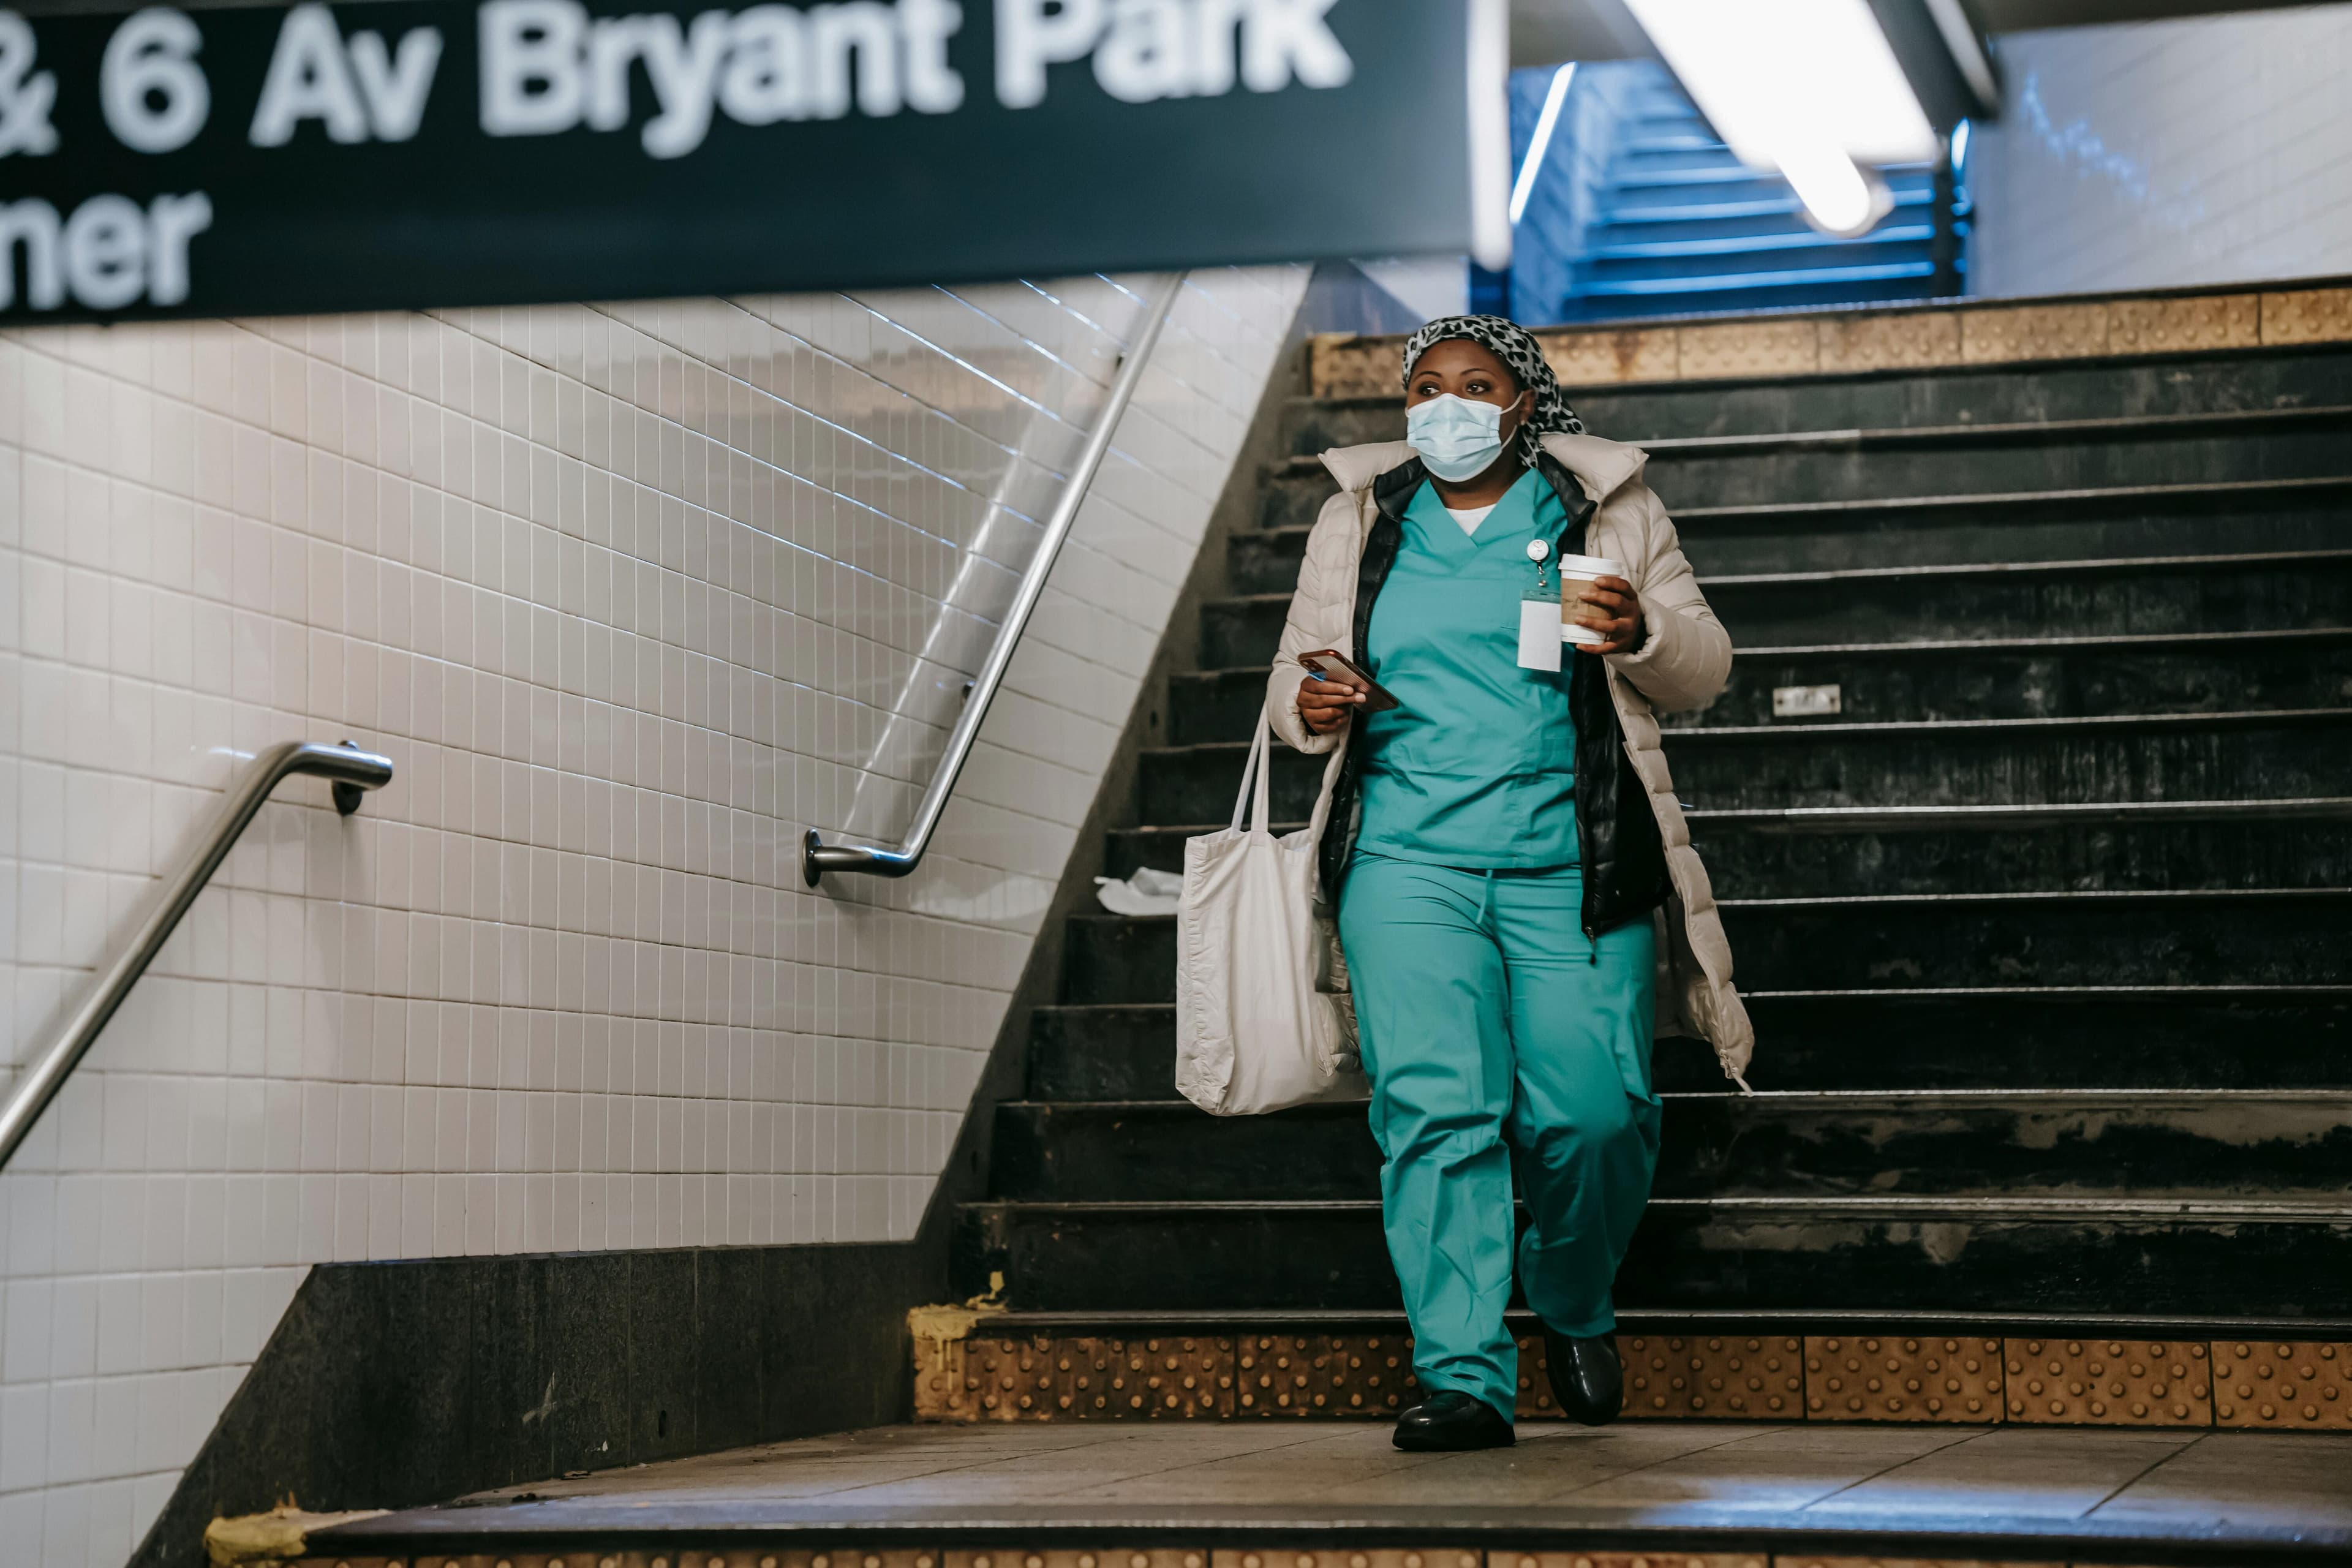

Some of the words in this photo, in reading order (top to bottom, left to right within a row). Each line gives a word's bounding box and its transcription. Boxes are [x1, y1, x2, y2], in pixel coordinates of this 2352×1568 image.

[104, 11, 207, 150] 6
[252, 6, 440, 145] Av
[481, 0, 963, 157] Bryant
[995, 0, 1354, 108] Park
